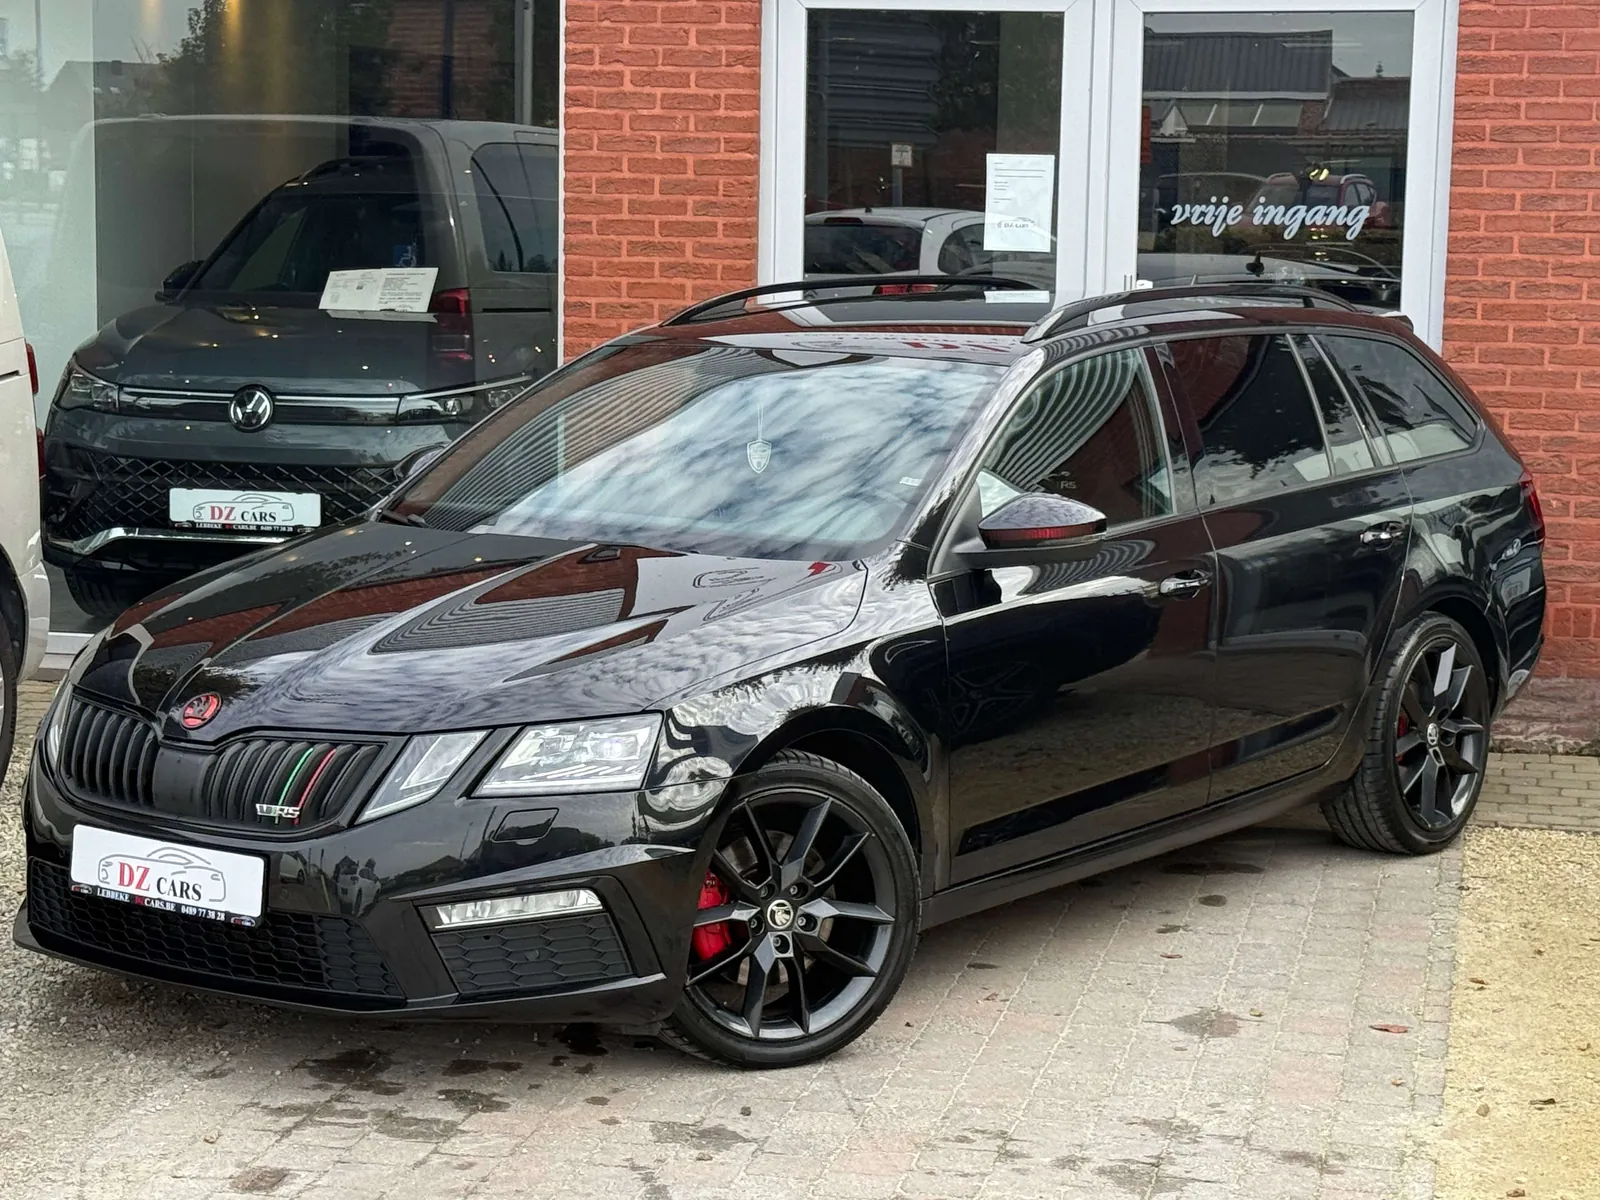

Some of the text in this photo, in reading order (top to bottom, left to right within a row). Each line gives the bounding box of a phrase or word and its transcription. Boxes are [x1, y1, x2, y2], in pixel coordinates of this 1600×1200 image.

[1170, 196, 1370, 240] vrije ingang
[210, 505, 277, 523] DZ CARS
[118, 861, 202, 902] DZ CARS
[97, 887, 130, 903] LEBBEKE
[181, 904, 197, 915] 0489
[198, 907, 207, 918] 77
[206, 909, 216, 920] 38
[216, 911, 226, 922] 28
